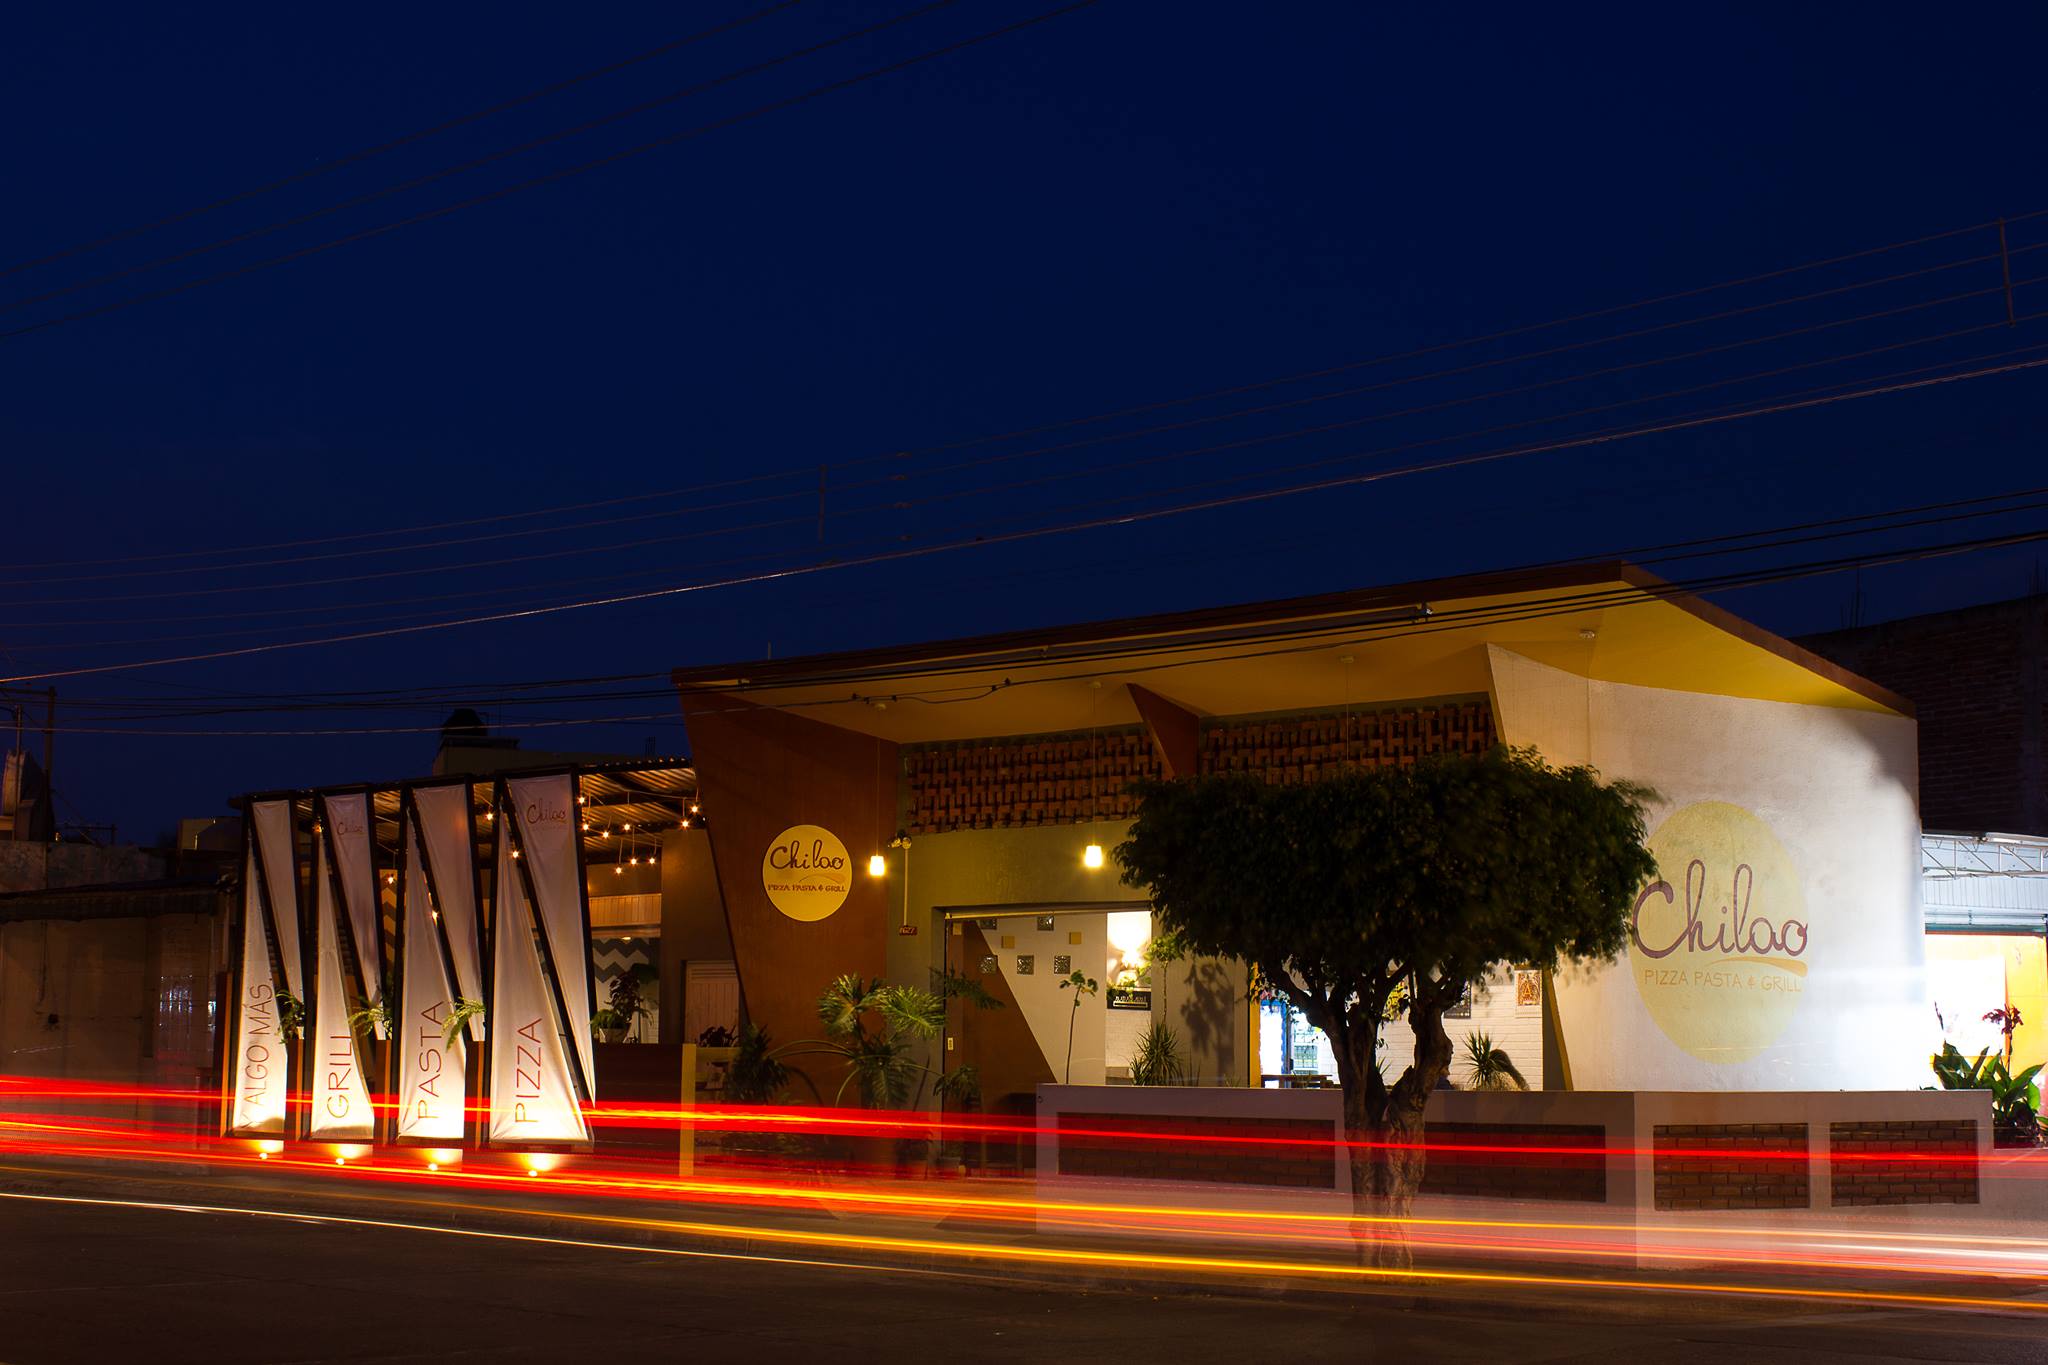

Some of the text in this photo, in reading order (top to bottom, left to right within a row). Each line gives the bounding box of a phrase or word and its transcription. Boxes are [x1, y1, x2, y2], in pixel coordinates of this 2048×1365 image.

[770, 840, 845, 870] Chilao
[1632, 859, 1808, 959] Chilao
[1644, 970, 1688, 985] PIZZA
[1694, 972, 1742, 989] PASTA
[1761, 976, 1802, 992] GRILL
[244, 1045, 269, 1106] ALGO
[418, 1001, 444, 1119] PASTA
[515, 1018, 542, 1123] PIZZA
